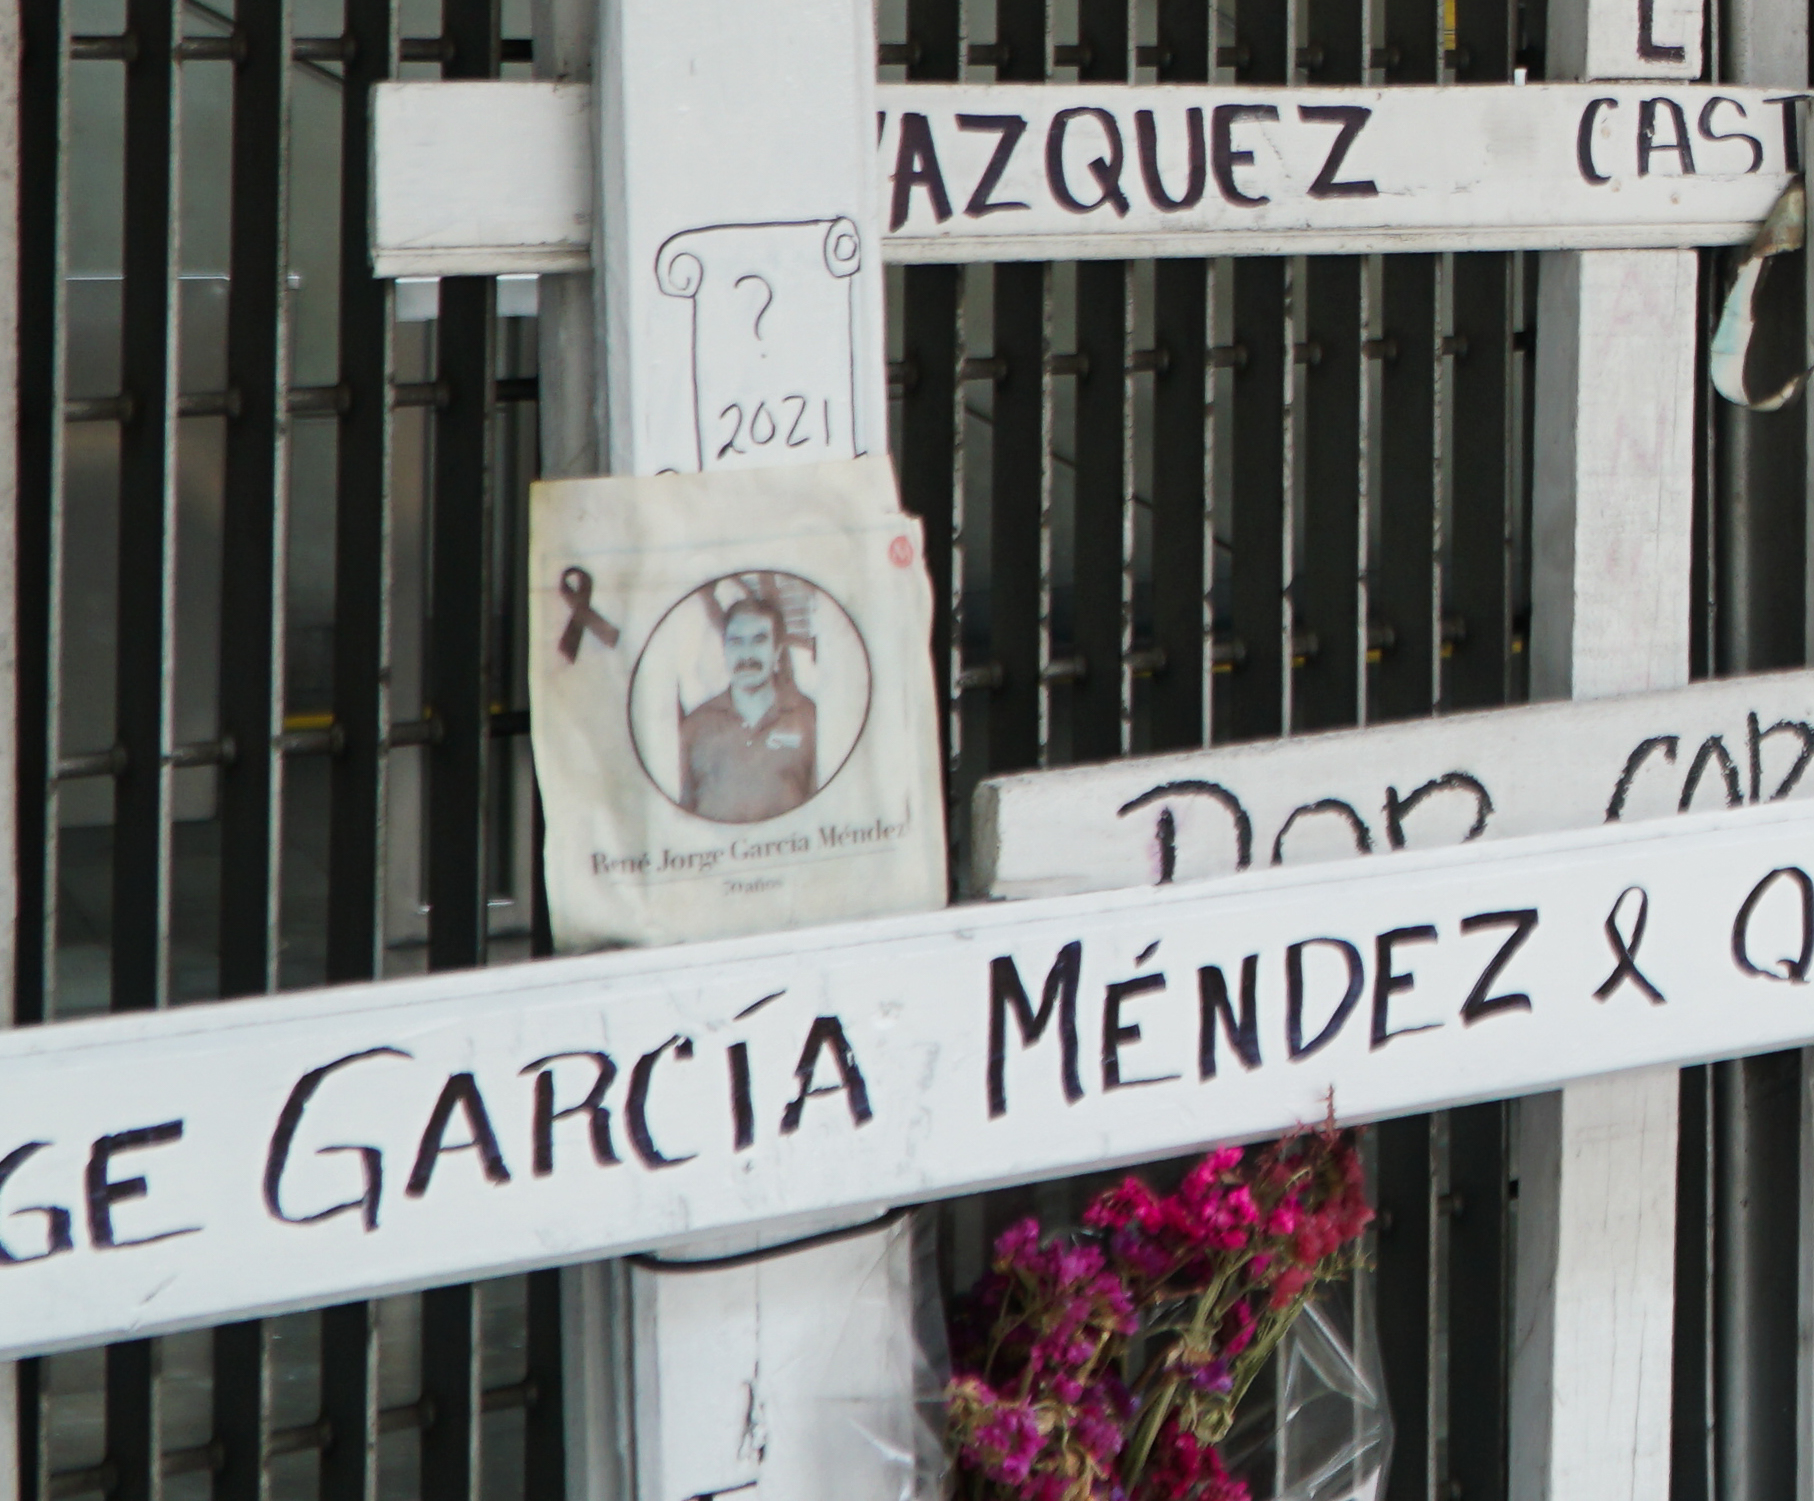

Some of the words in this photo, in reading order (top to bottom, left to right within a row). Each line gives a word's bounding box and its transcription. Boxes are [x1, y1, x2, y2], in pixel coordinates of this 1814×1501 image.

[876, 103, 1380, 233] AZQUEZ
[715, 393, 833, 461] 2021
[656, 844, 725, 874] Jorge
[730, 832, 810, 862] García
[262, 987, 874, 1233] GARCÍA
[986, 907, 1541, 1123] MÉNDEZ
